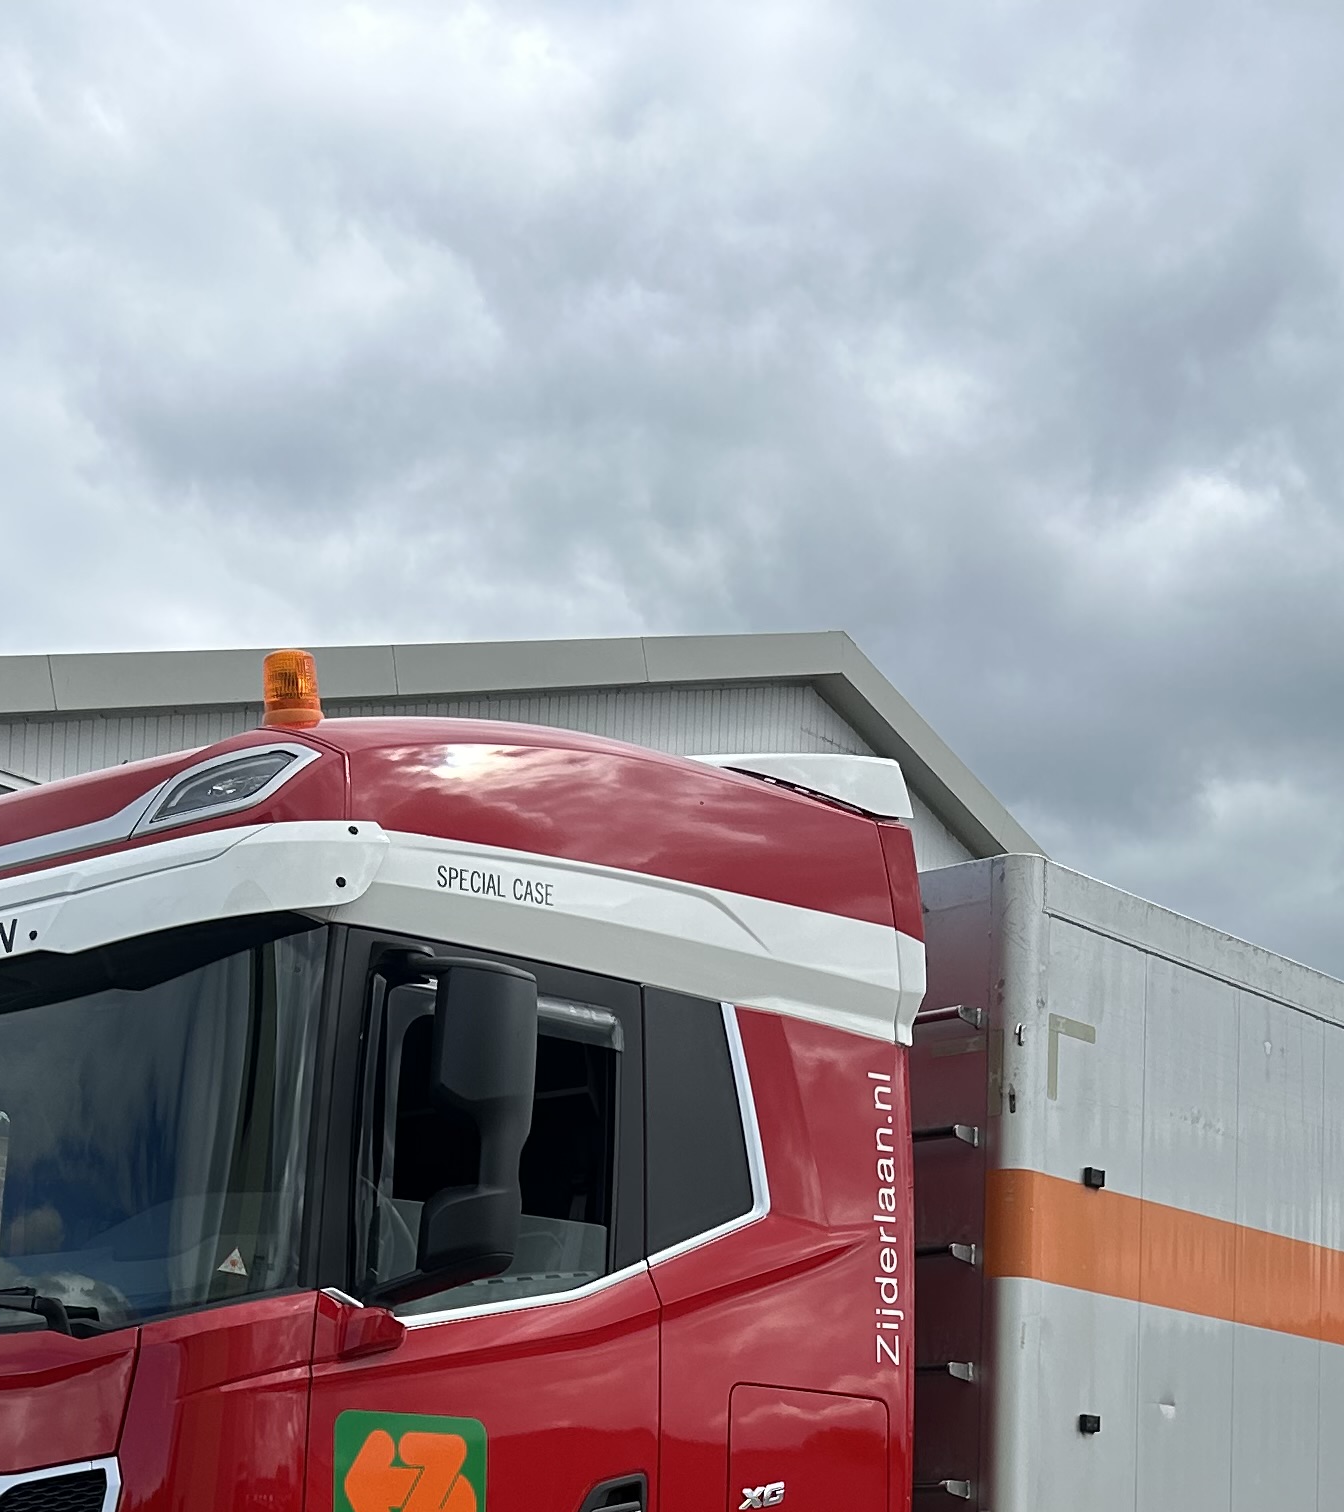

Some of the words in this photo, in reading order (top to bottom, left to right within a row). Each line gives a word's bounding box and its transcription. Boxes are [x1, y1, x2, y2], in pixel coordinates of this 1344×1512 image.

[437, 865, 506, 898] SPECIAL
[513, 878, 554, 906] CASE
[867, 1072, 904, 1366] Zijderlaan.nl
[738, 1481, 785, 1511] XG
